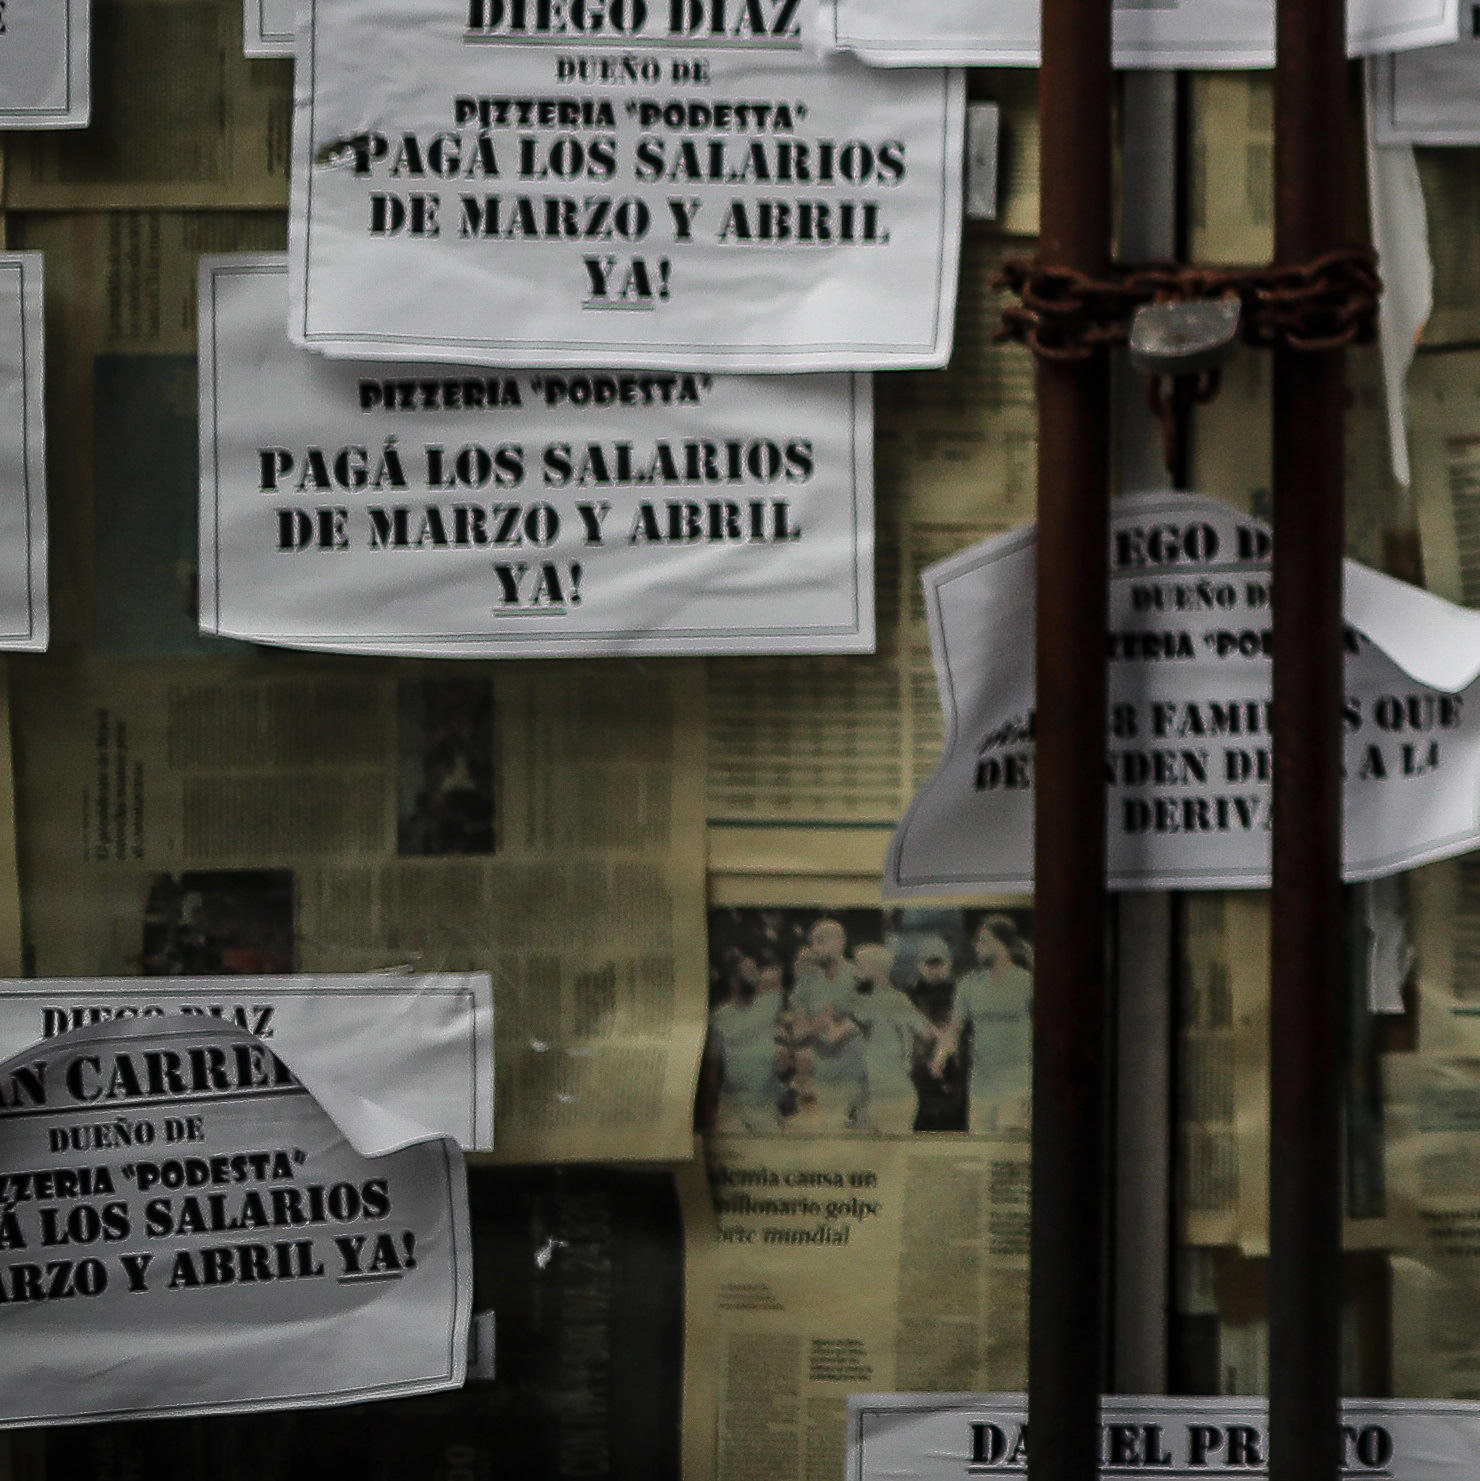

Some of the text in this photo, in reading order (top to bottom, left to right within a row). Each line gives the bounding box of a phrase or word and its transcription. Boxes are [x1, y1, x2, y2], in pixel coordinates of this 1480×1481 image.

[555, 53, 712, 85] DUEÑO DE
[369, 193, 890, 243] DE MARZO Y ABRIL
[255, 435, 815, 492] PAGÁ LOS SALARIOS
[43, 1115, 206, 1155] DUEÑO DE
[38, 1176, 393, 1248] LOS SALARIOS
